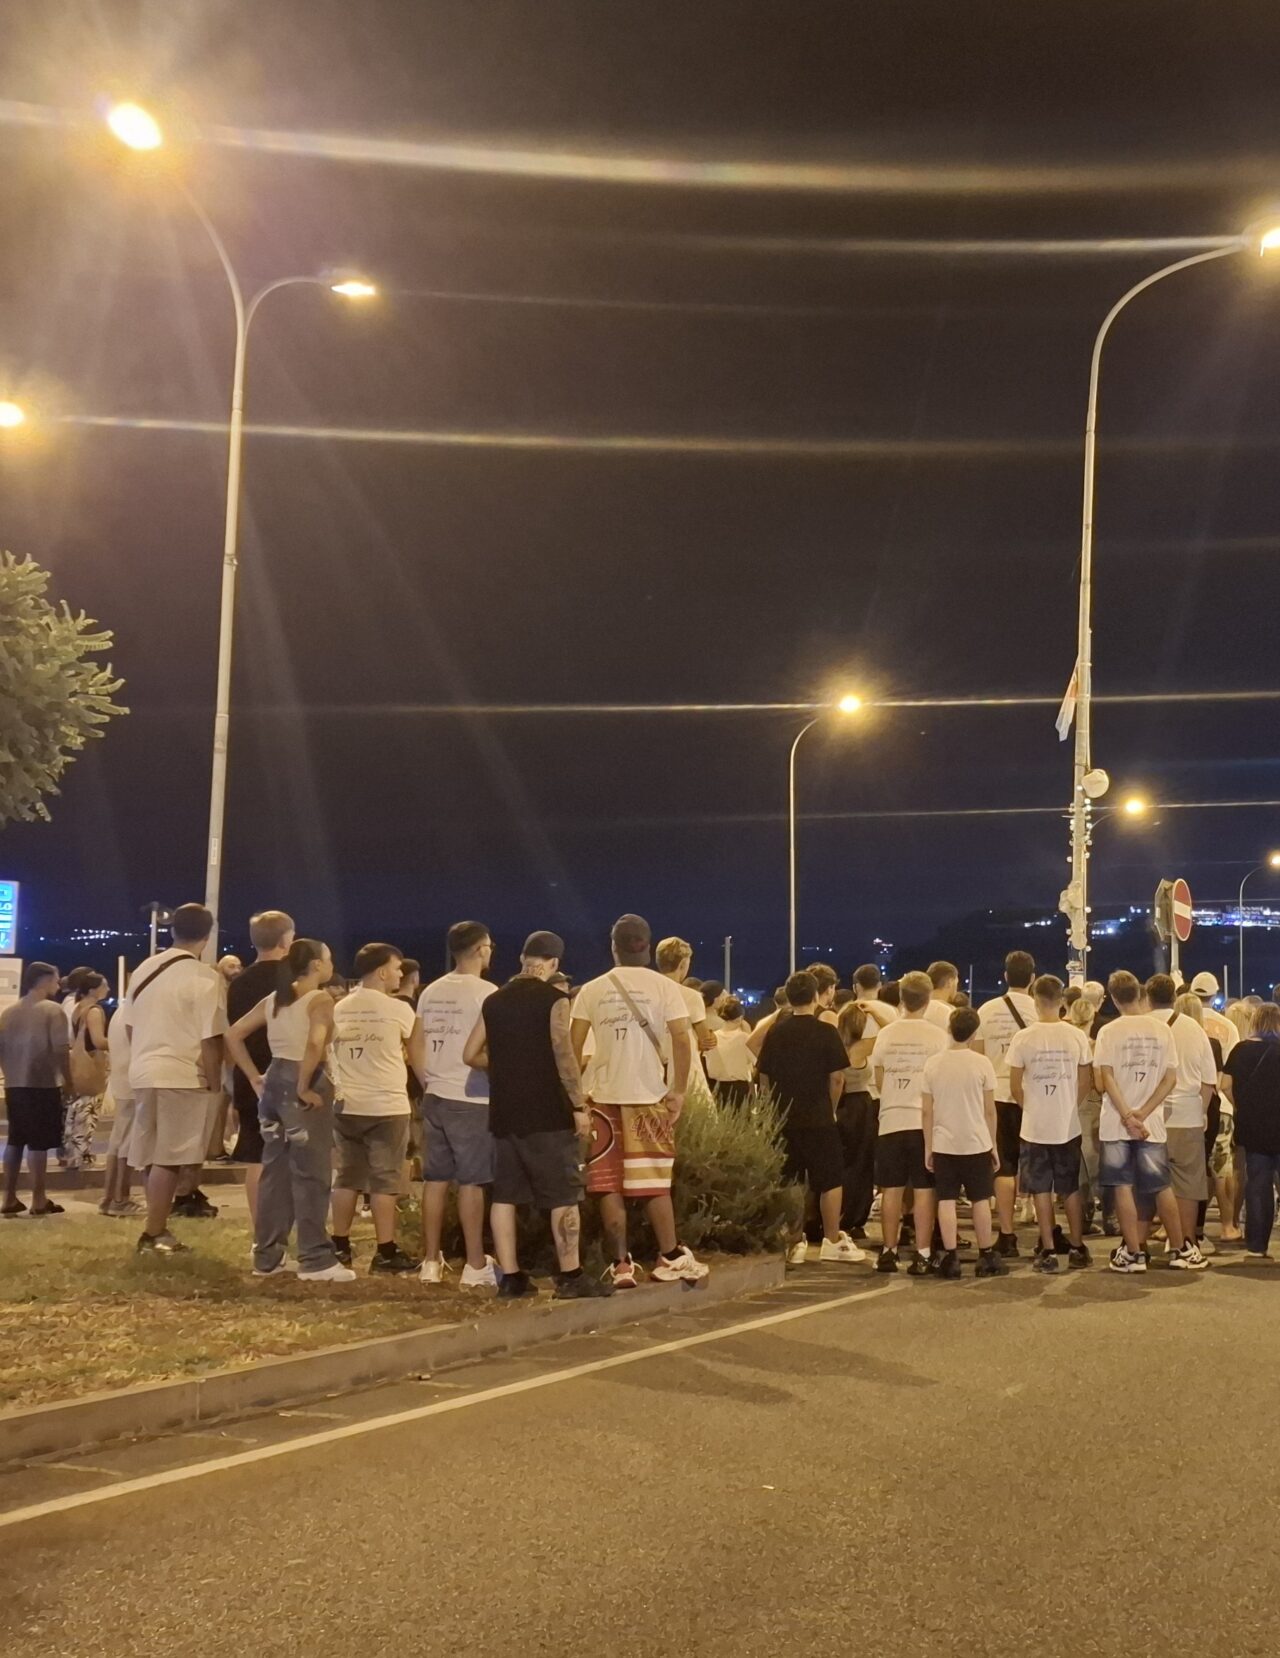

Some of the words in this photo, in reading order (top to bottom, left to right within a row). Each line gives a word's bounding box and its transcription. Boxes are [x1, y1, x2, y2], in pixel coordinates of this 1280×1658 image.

[615, 1027, 627, 1041] 17
[432, 1039, 444, 1053] 17
[349, 1047, 364, 1060] 17
[1134, 1071, 1146, 1083] 17
[897, 1078, 911, 1090] 17
[1044, 1084, 1057, 1096] 17
